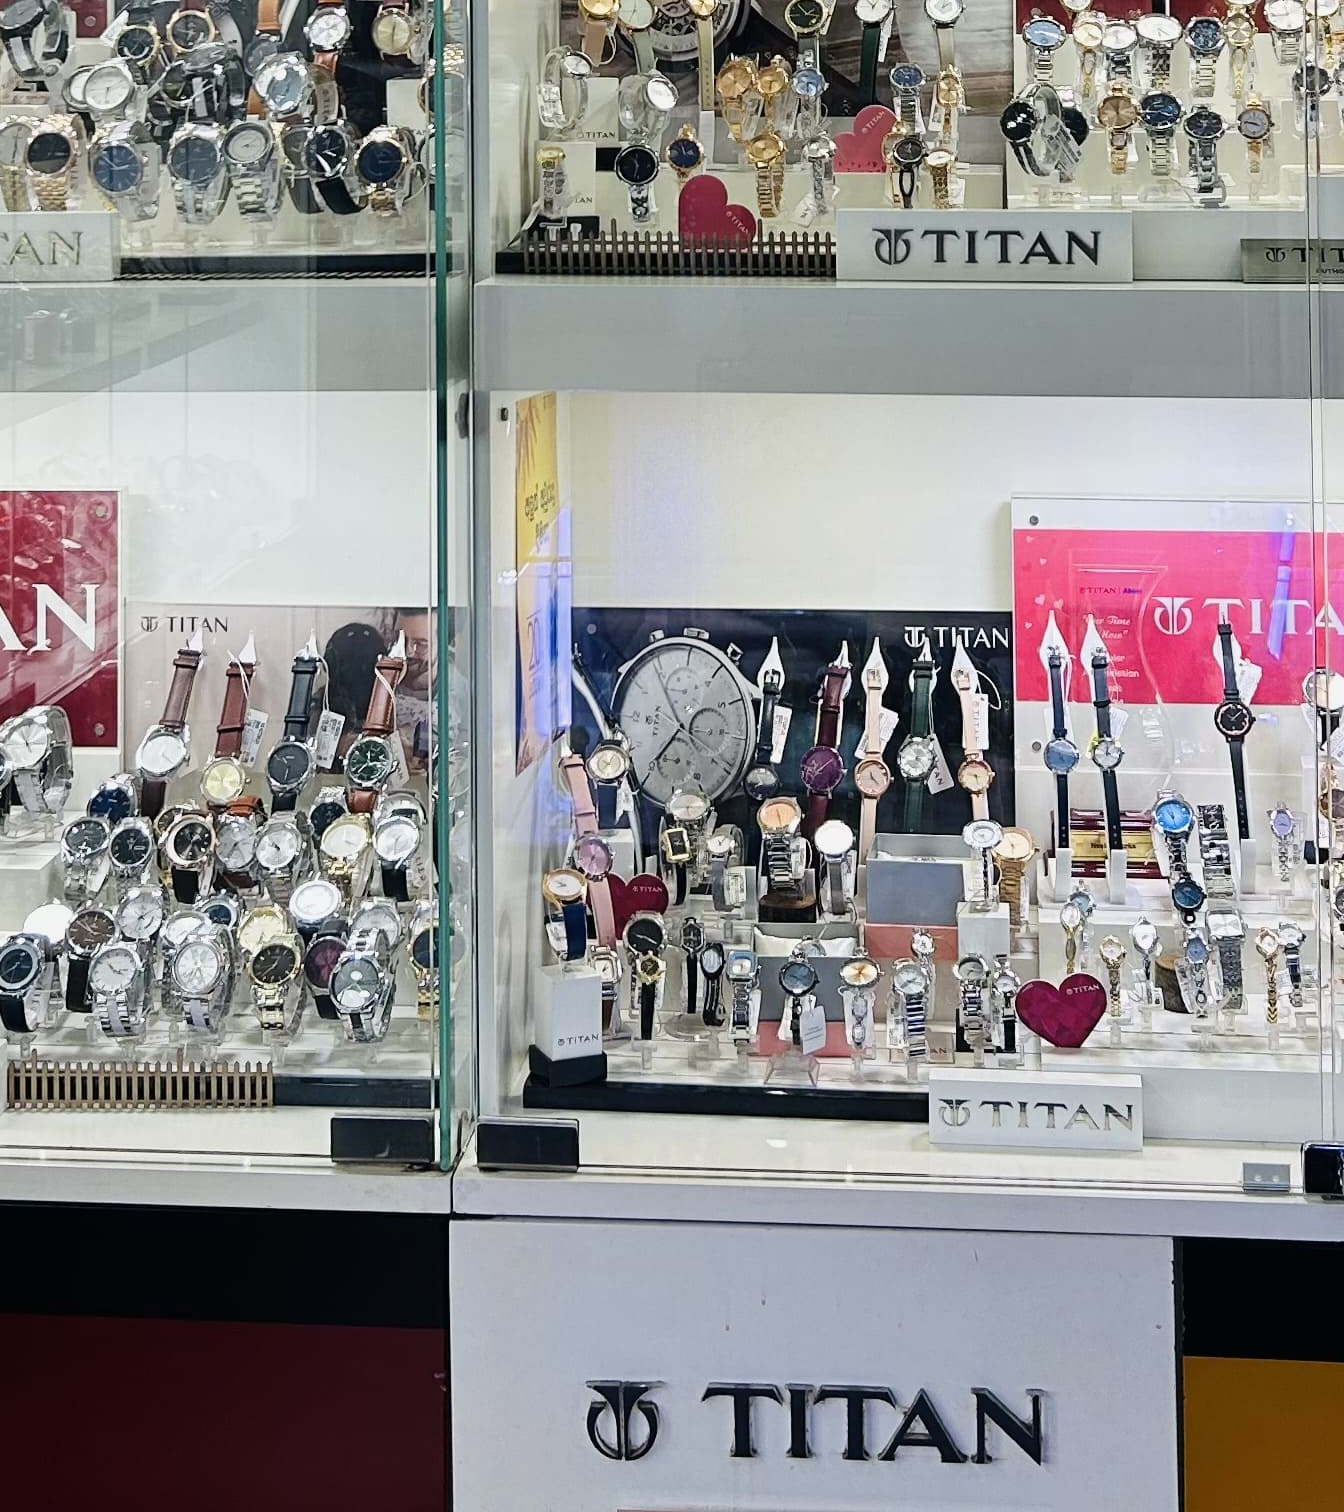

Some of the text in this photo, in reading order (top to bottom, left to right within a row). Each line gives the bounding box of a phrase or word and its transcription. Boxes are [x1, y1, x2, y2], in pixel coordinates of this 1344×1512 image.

[920, 229, 1102, 267] TITAN
[167, 616, 229, 634] TITAN
[935, 626, 1009, 648] TITAN
[568, 1033, 599, 1046] TITAN
[979, 1098, 1135, 1132] TITAN
[701, 1382, 1047, 1466] TITAN
